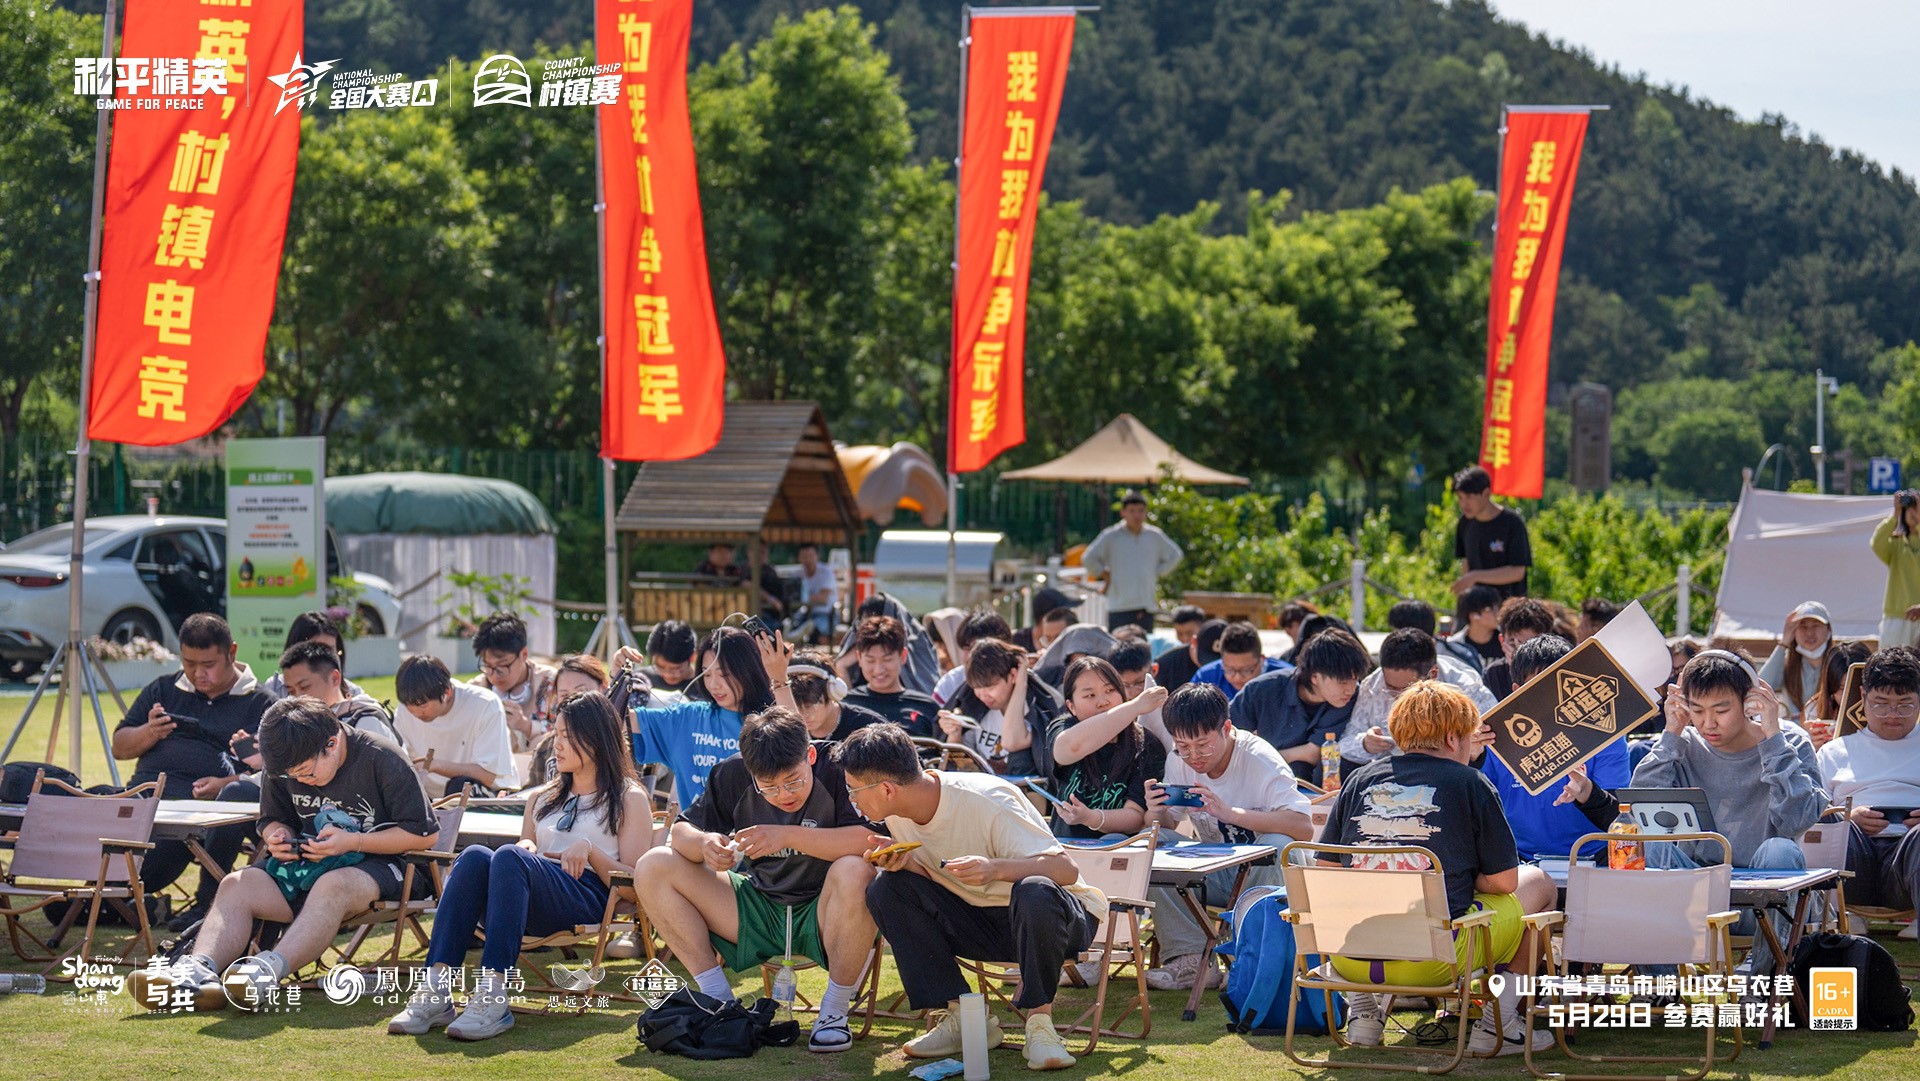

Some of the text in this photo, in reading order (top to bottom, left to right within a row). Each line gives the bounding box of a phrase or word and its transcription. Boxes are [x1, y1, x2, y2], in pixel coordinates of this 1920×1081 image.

[137, 0, 252, 423] 英，村镇电竞
[1871, 459, 1895, 490] P
[1559, 679, 1616, 723] 村运会
[692, 754, 717, 767] YOUR
[1519, 731, 1574, 776] 虎牙直播
